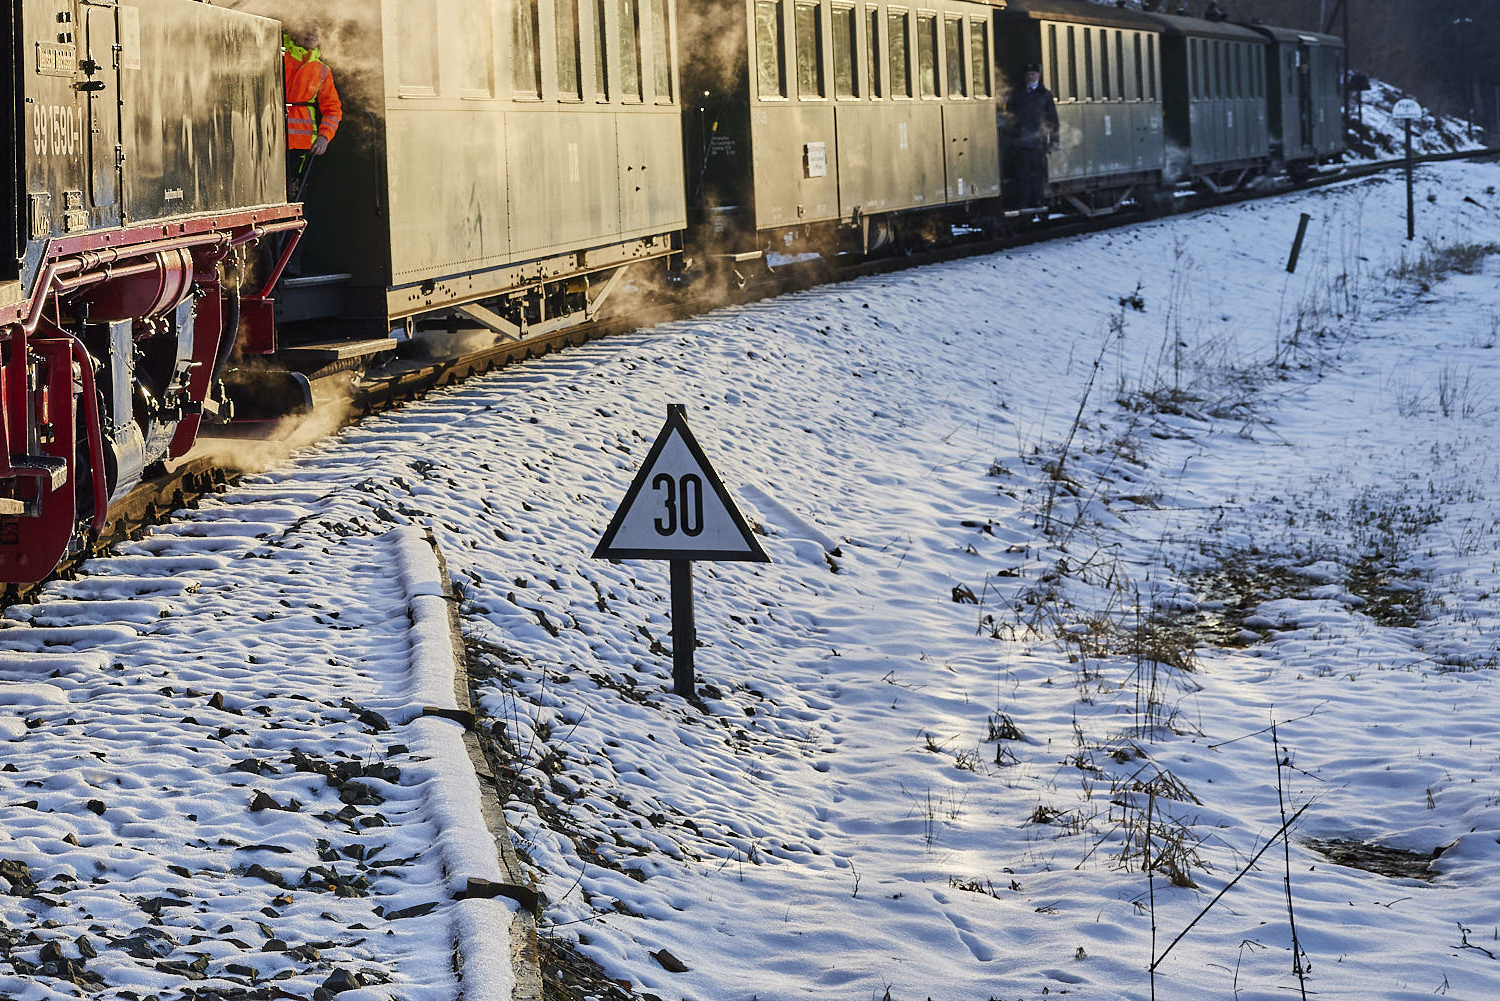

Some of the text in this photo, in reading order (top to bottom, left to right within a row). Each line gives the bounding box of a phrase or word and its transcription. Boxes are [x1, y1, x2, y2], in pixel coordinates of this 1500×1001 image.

[33, 104, 84, 156] 99 1590-1
[652, 473, 704, 537] 30
